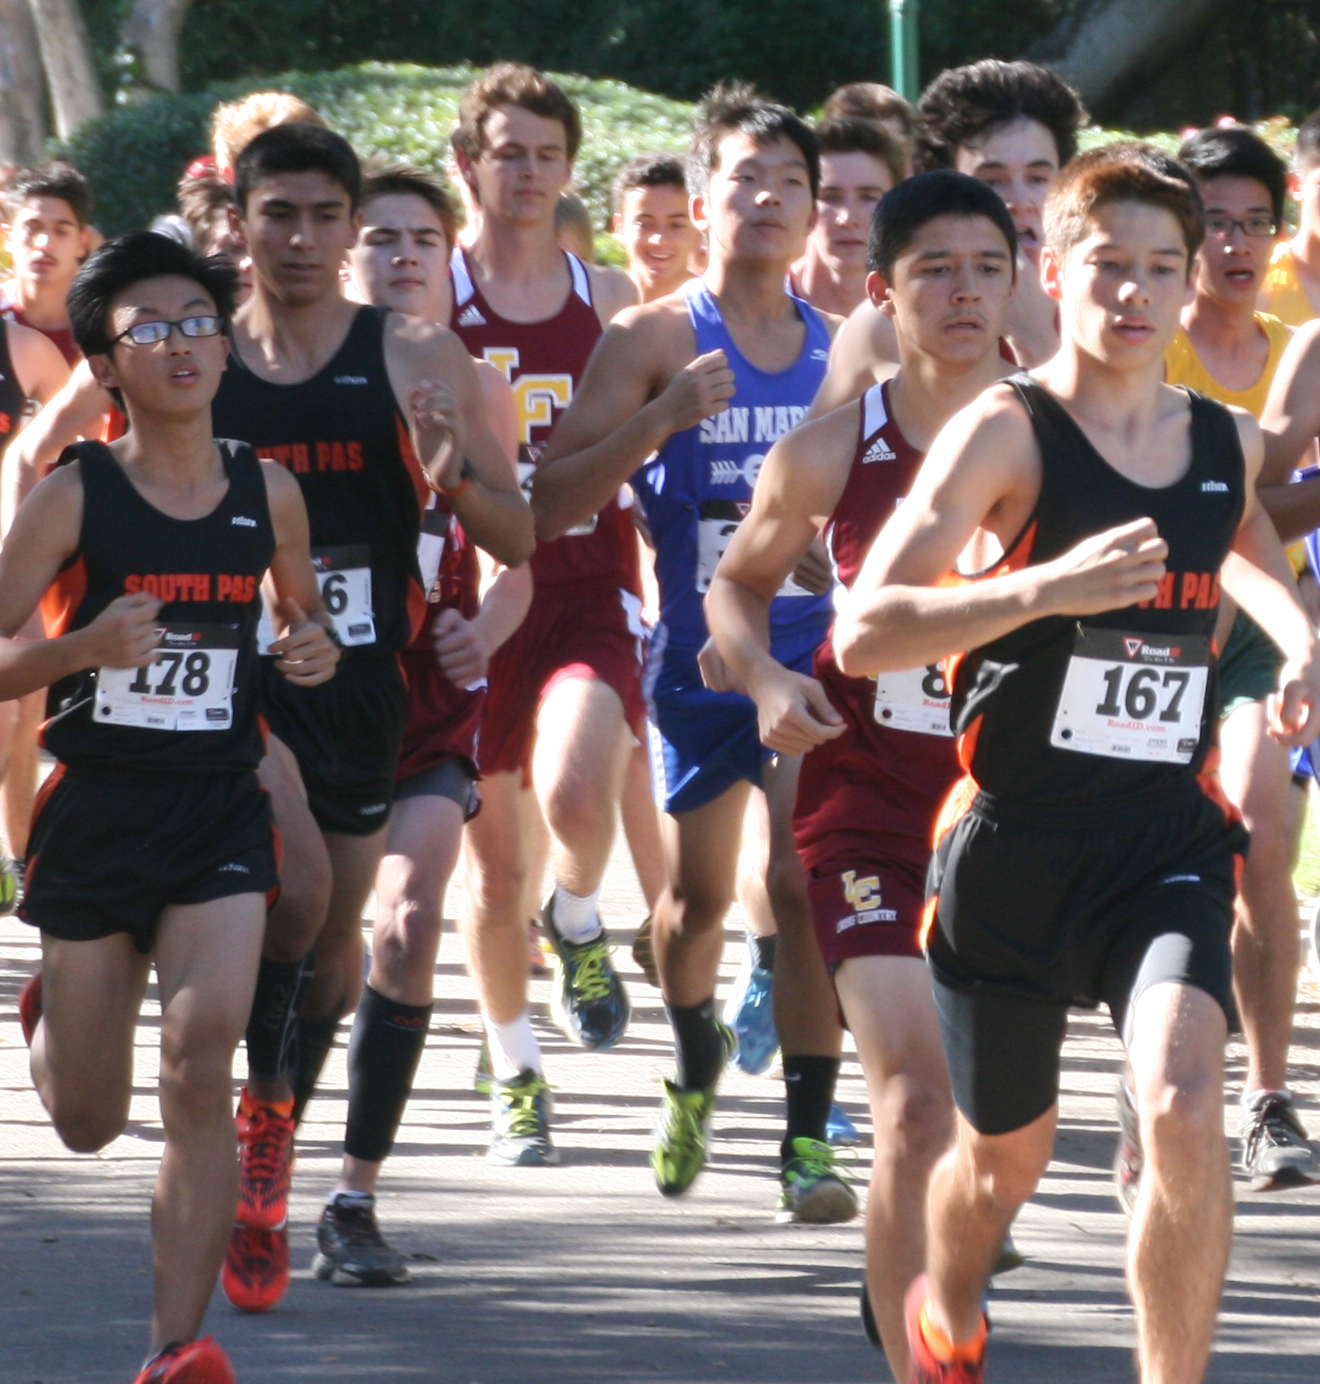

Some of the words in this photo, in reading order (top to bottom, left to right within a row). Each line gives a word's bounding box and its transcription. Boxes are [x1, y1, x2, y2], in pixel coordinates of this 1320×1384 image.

[699, 406, 750, 444] SAN
[753, 405, 812, 443] MAR
[314, 441, 364, 472] PAS
[862, 452, 897, 464] adidas
[124, 573, 211, 603] SOUTH
[217, 574, 257, 603] PAS
[129, 651, 211, 697] 178
[1095, 664, 1191, 723] 167
[1106, 718, 1167, 733] RoadID.com
[841, 869, 882, 912] LC
